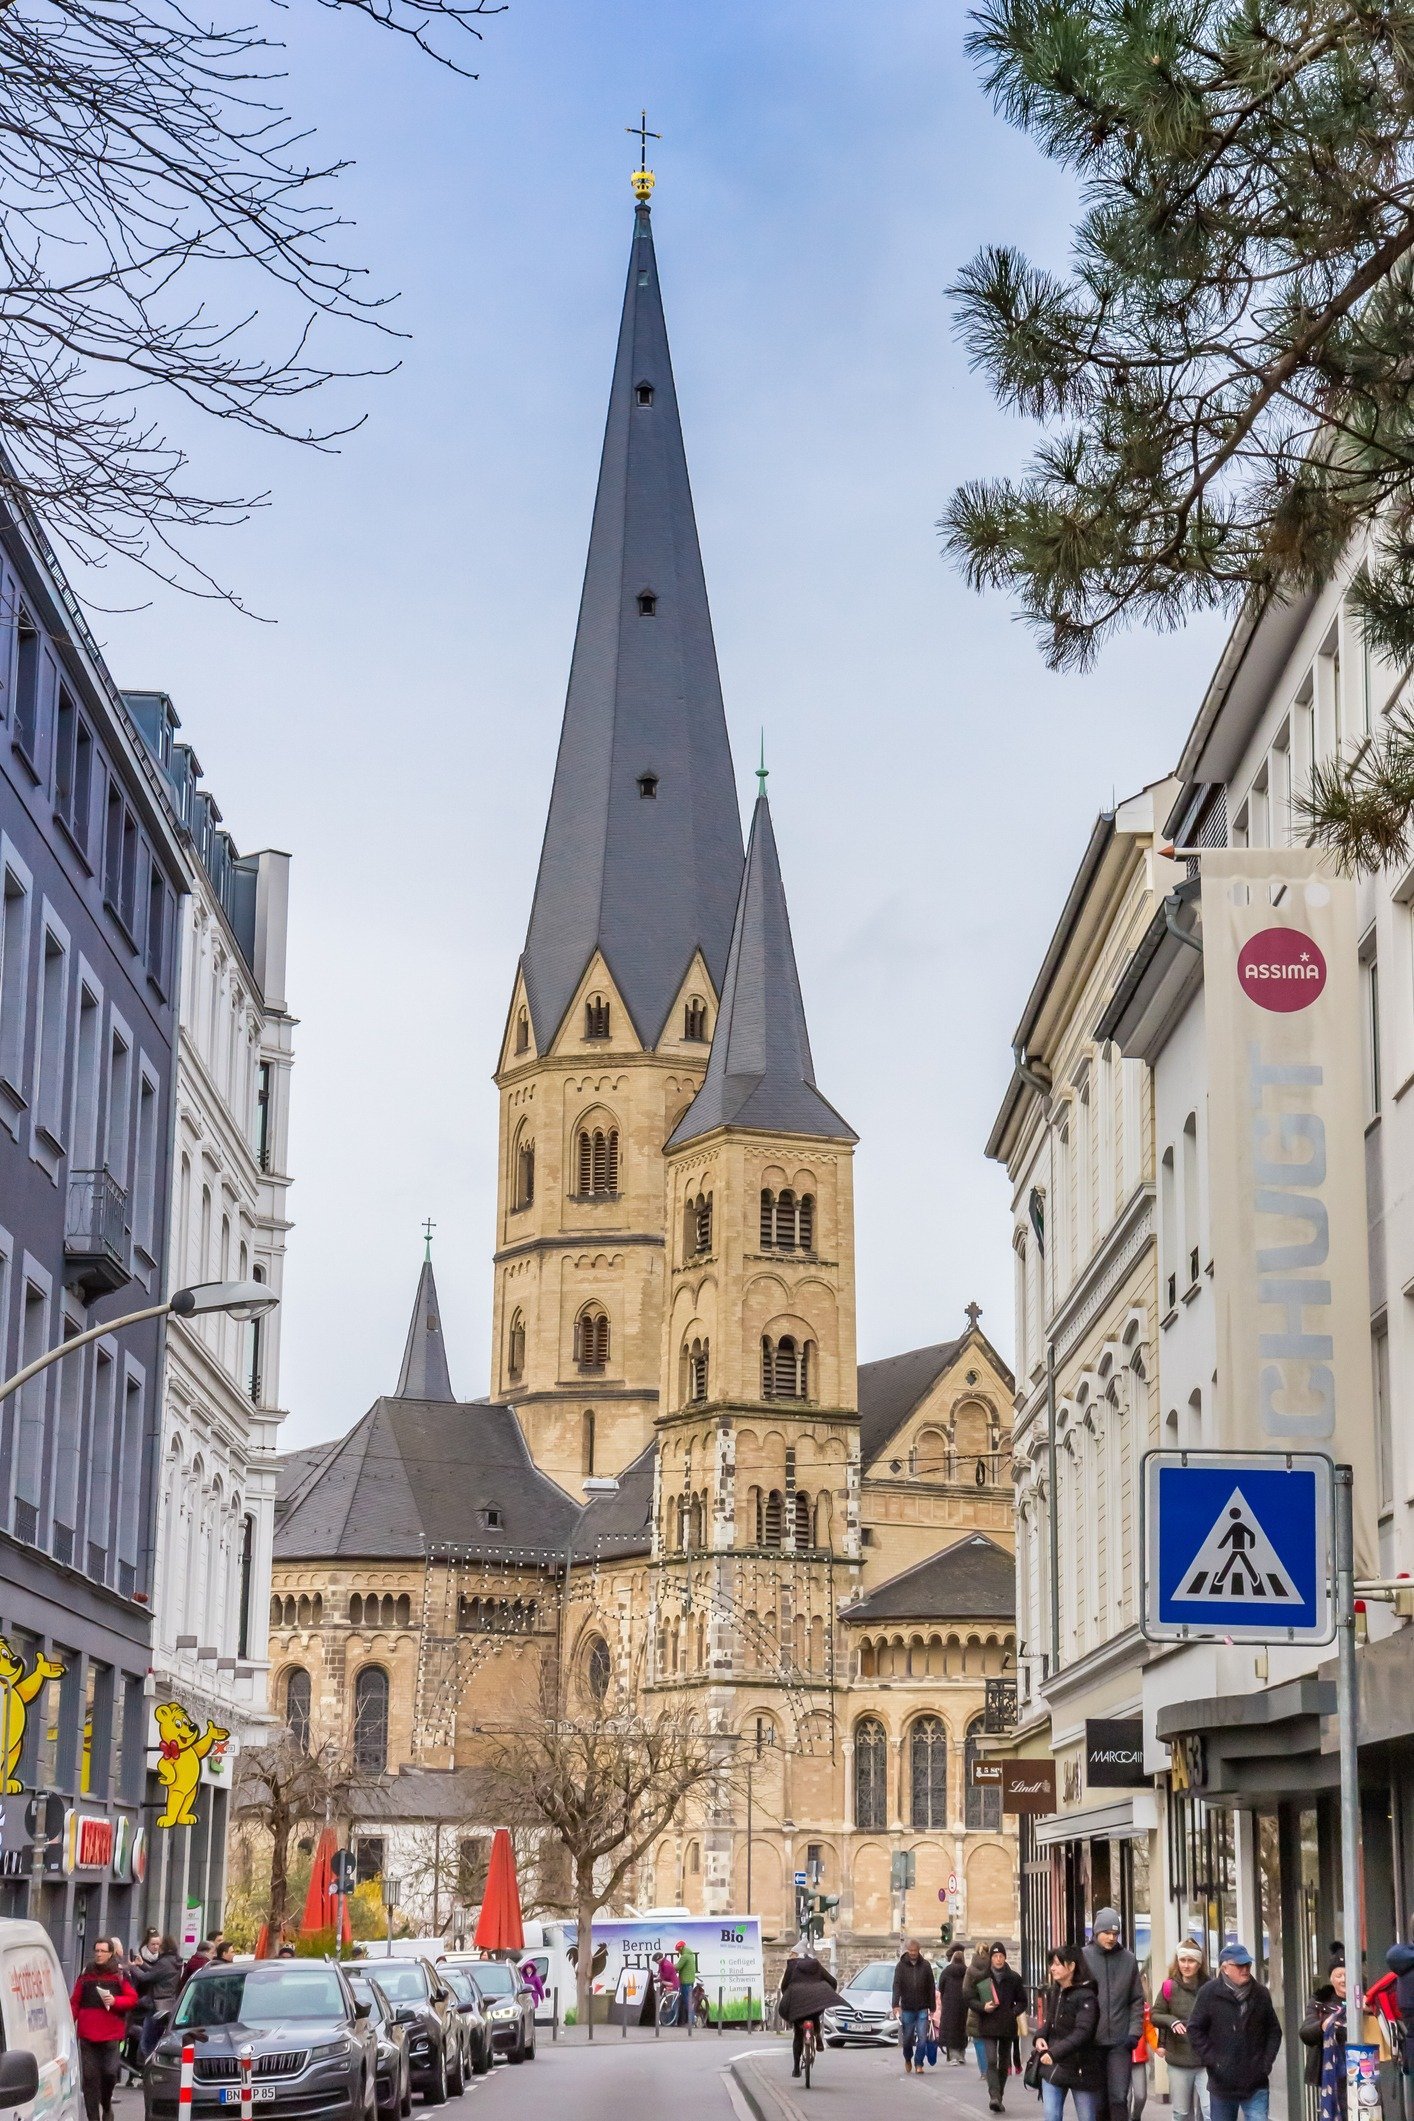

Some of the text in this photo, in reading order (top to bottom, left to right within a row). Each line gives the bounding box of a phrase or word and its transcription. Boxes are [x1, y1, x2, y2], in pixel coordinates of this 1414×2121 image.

[1245, 964, 1319, 979] ASSIMA
[1248, 1041, 1336, 1451] CHUGT
[721, 1929, 744, 1943] Bio
[622, 1938, 661, 1952] Bernd
